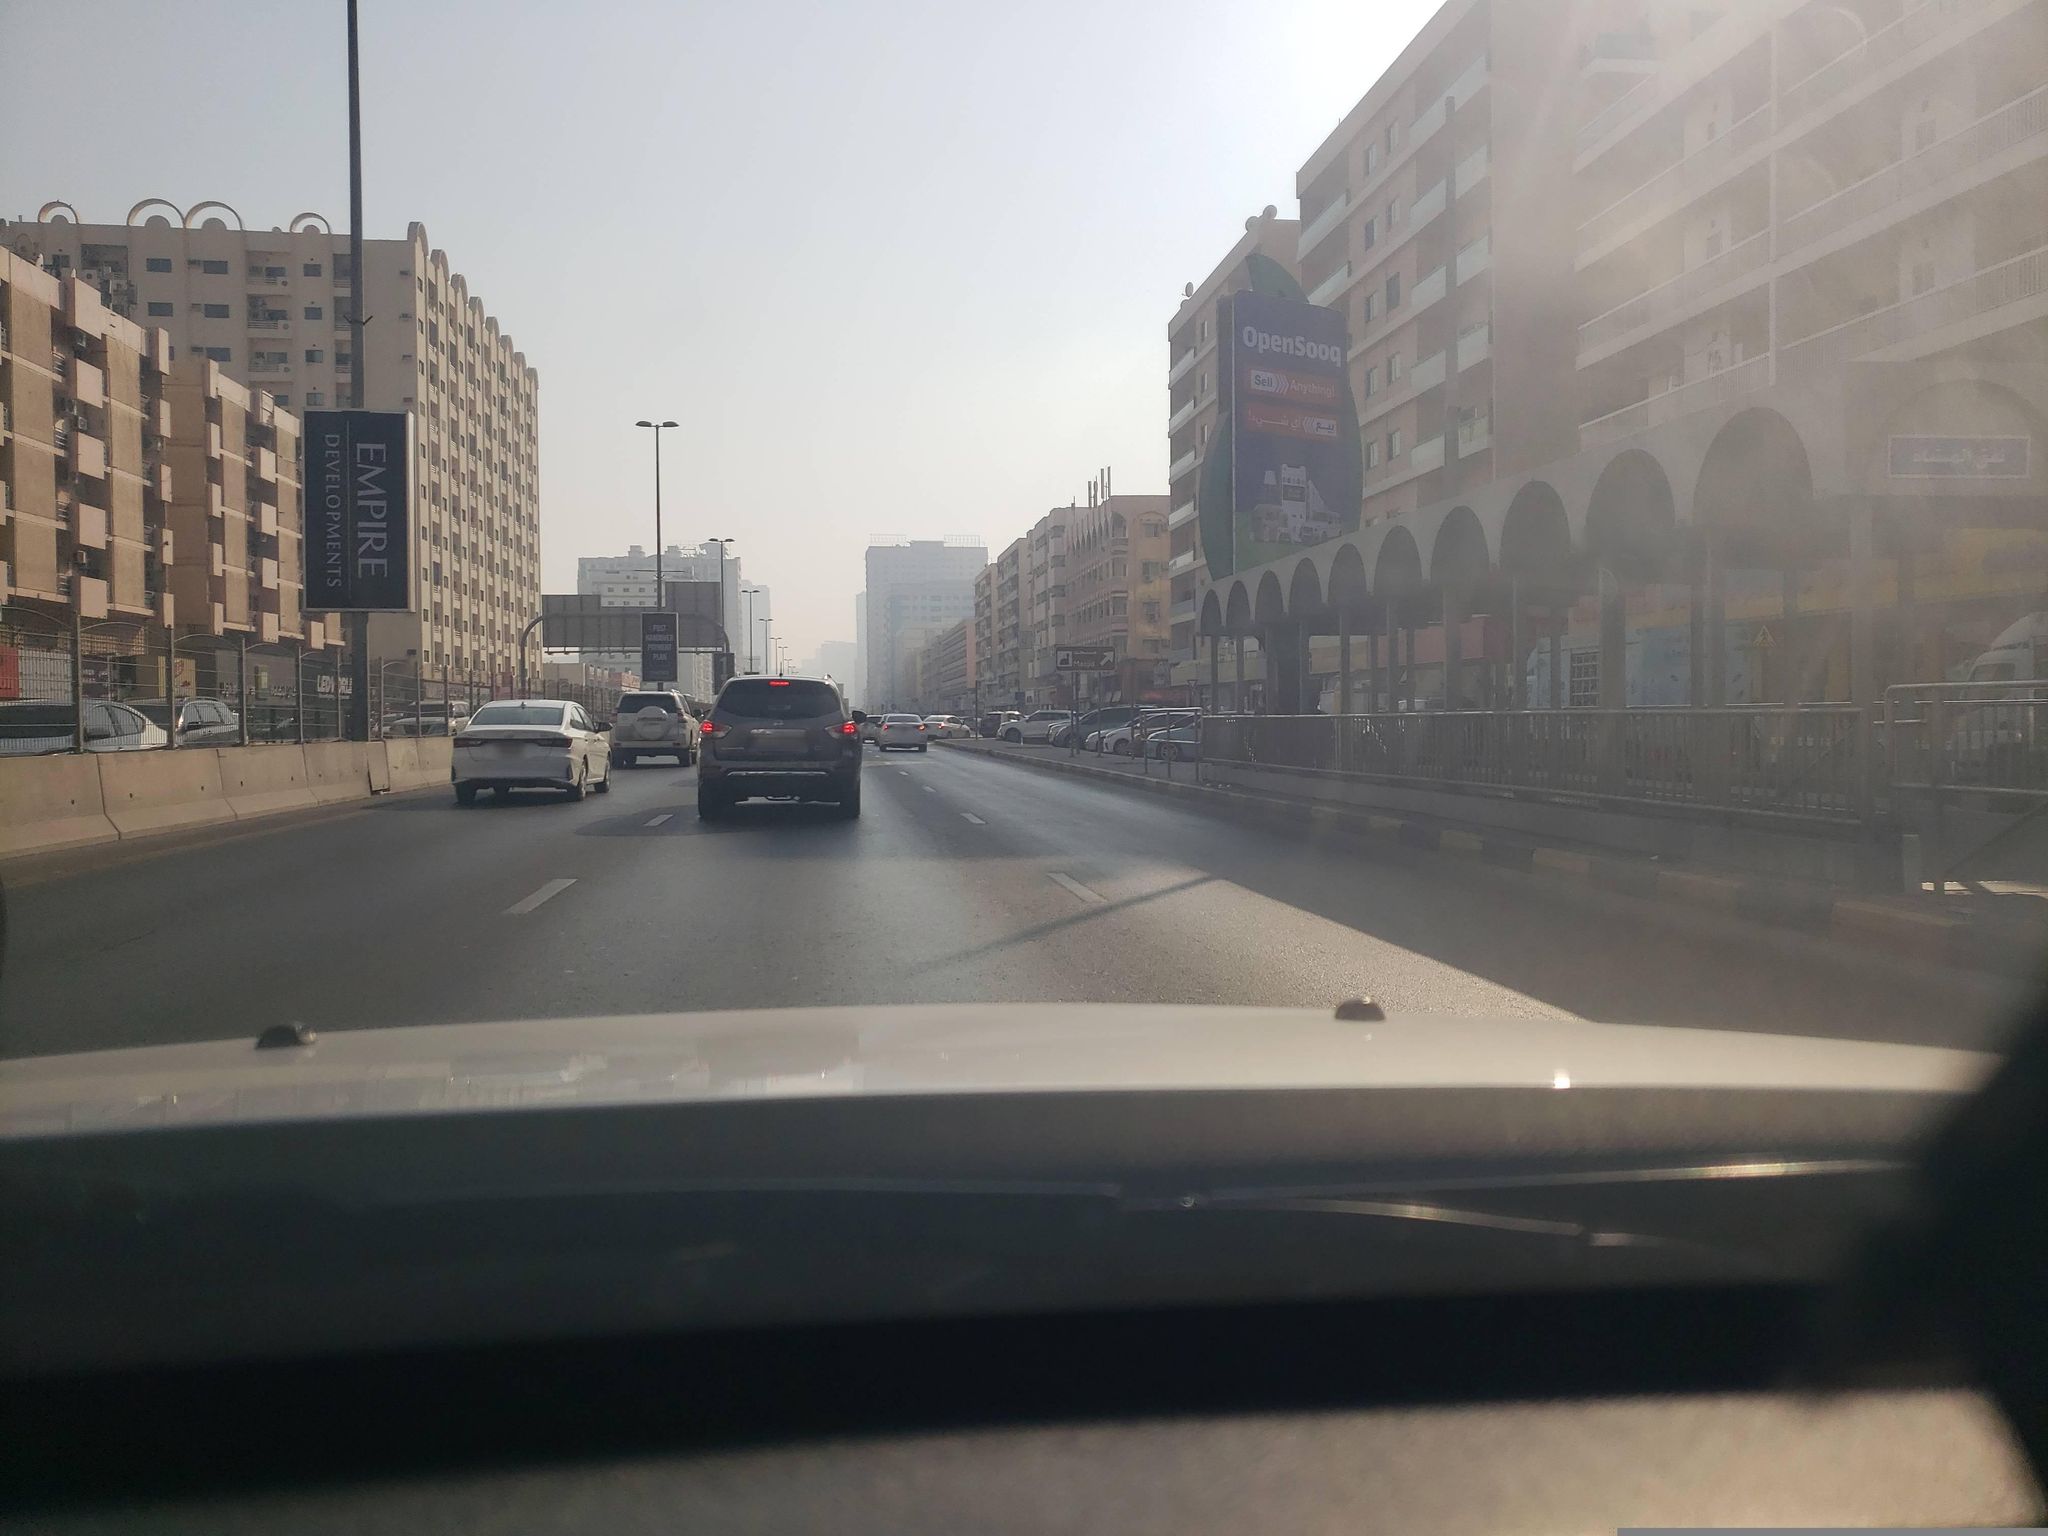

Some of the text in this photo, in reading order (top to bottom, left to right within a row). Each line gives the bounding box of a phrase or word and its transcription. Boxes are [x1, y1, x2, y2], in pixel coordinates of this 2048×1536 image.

[1242, 326, 1342, 368] OpenSooq
[1254, 374, 1273, 388] Sell
[324, 433, 342, 588] DEVELOPMENTS
[356, 442, 388, 578] EMPIRE
